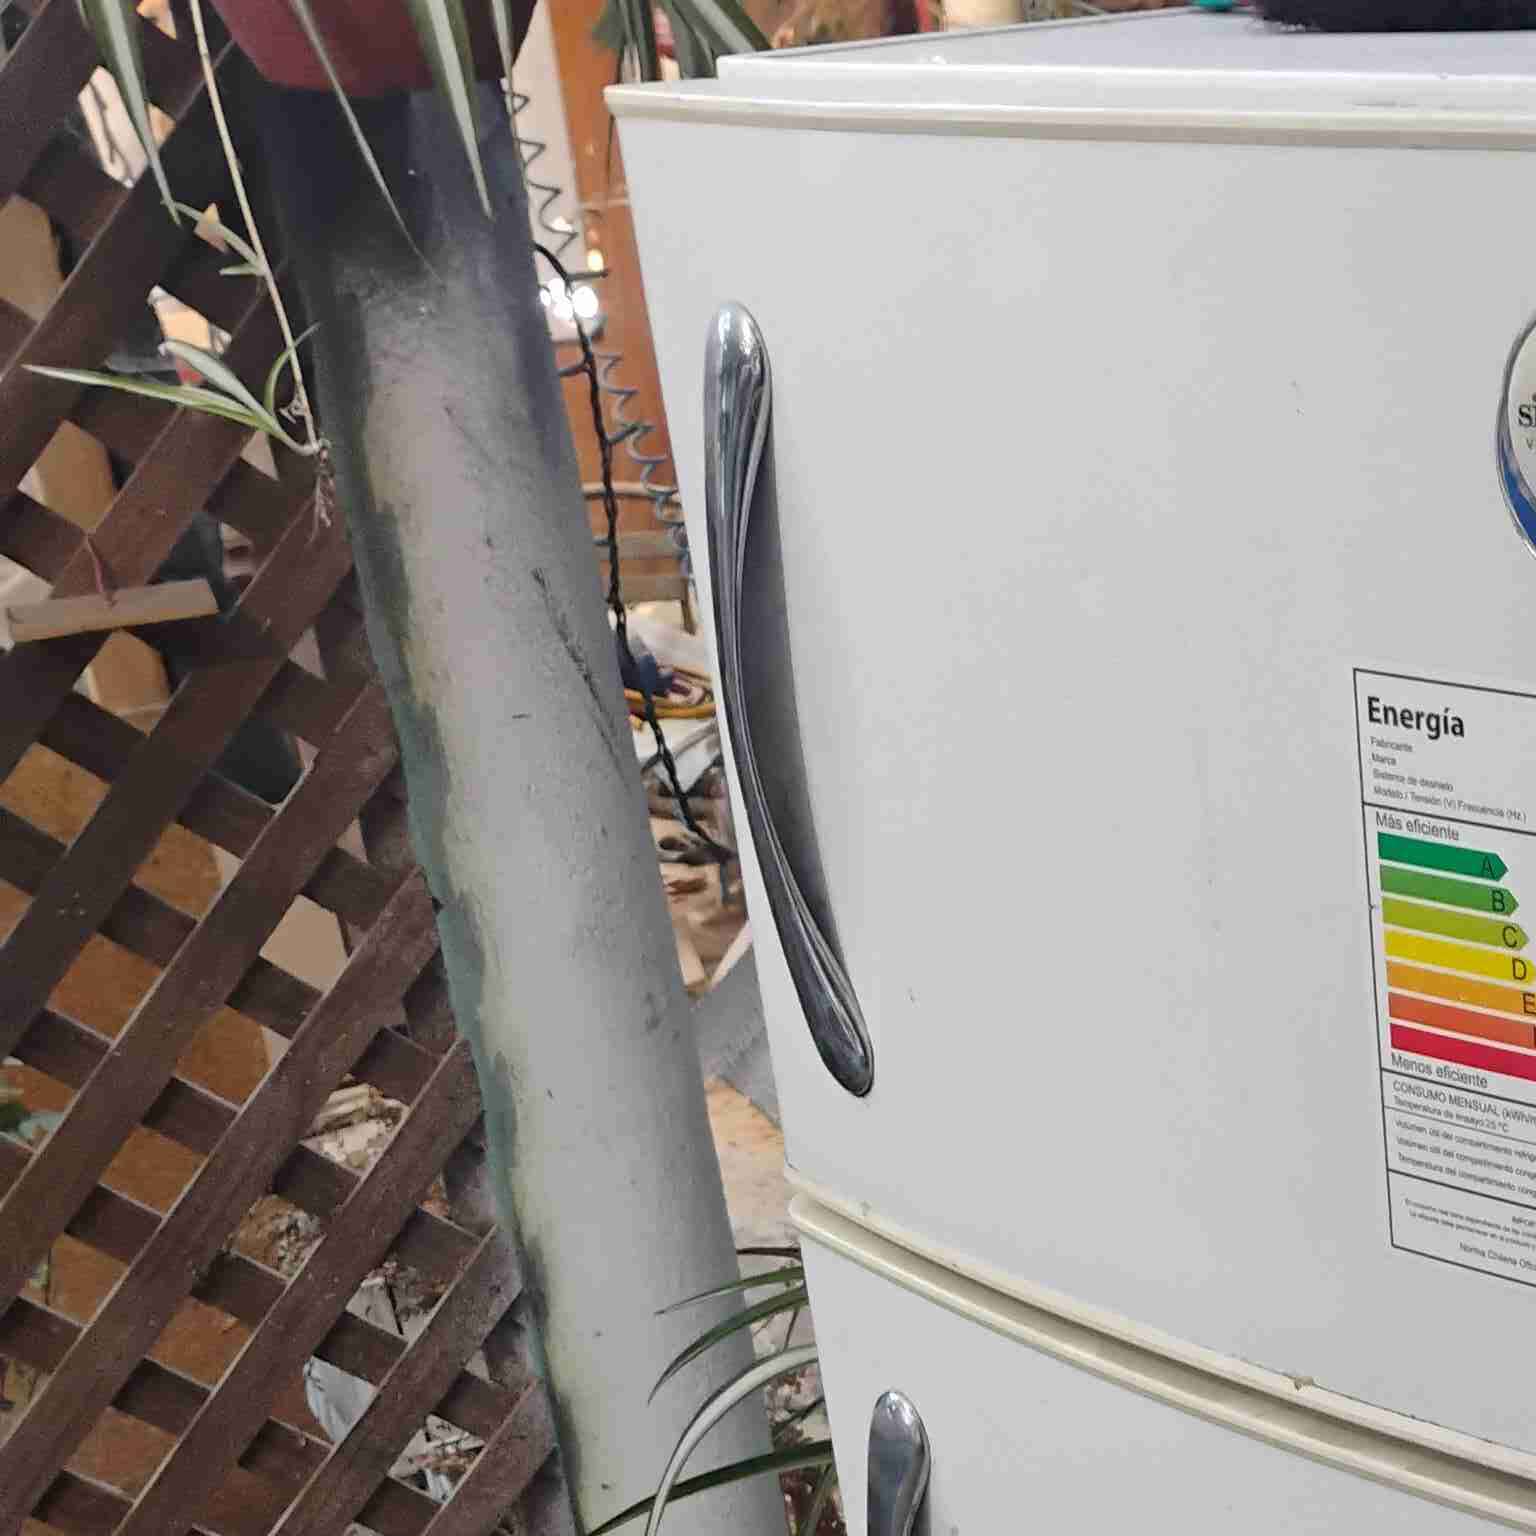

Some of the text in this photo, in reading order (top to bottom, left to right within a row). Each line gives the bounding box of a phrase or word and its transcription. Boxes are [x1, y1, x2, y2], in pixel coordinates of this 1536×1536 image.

[1367, 696, 1465, 740] Energía
[1376, 811, 1459, 841] Más eficiente
[1482, 855, 1494, 876] A
[1492, 889, 1505, 913] B
[1502, 926, 1518, 949] C
[1512, 958, 1527, 981] D
[1523, 992, 1536, 1016] E
[1391, 1055, 1488, 1088] Menos eficiente
[1393, 1080, 1447, 1104] CONSUMO
[1449, 1095, 1500, 1116] MENSUAL
